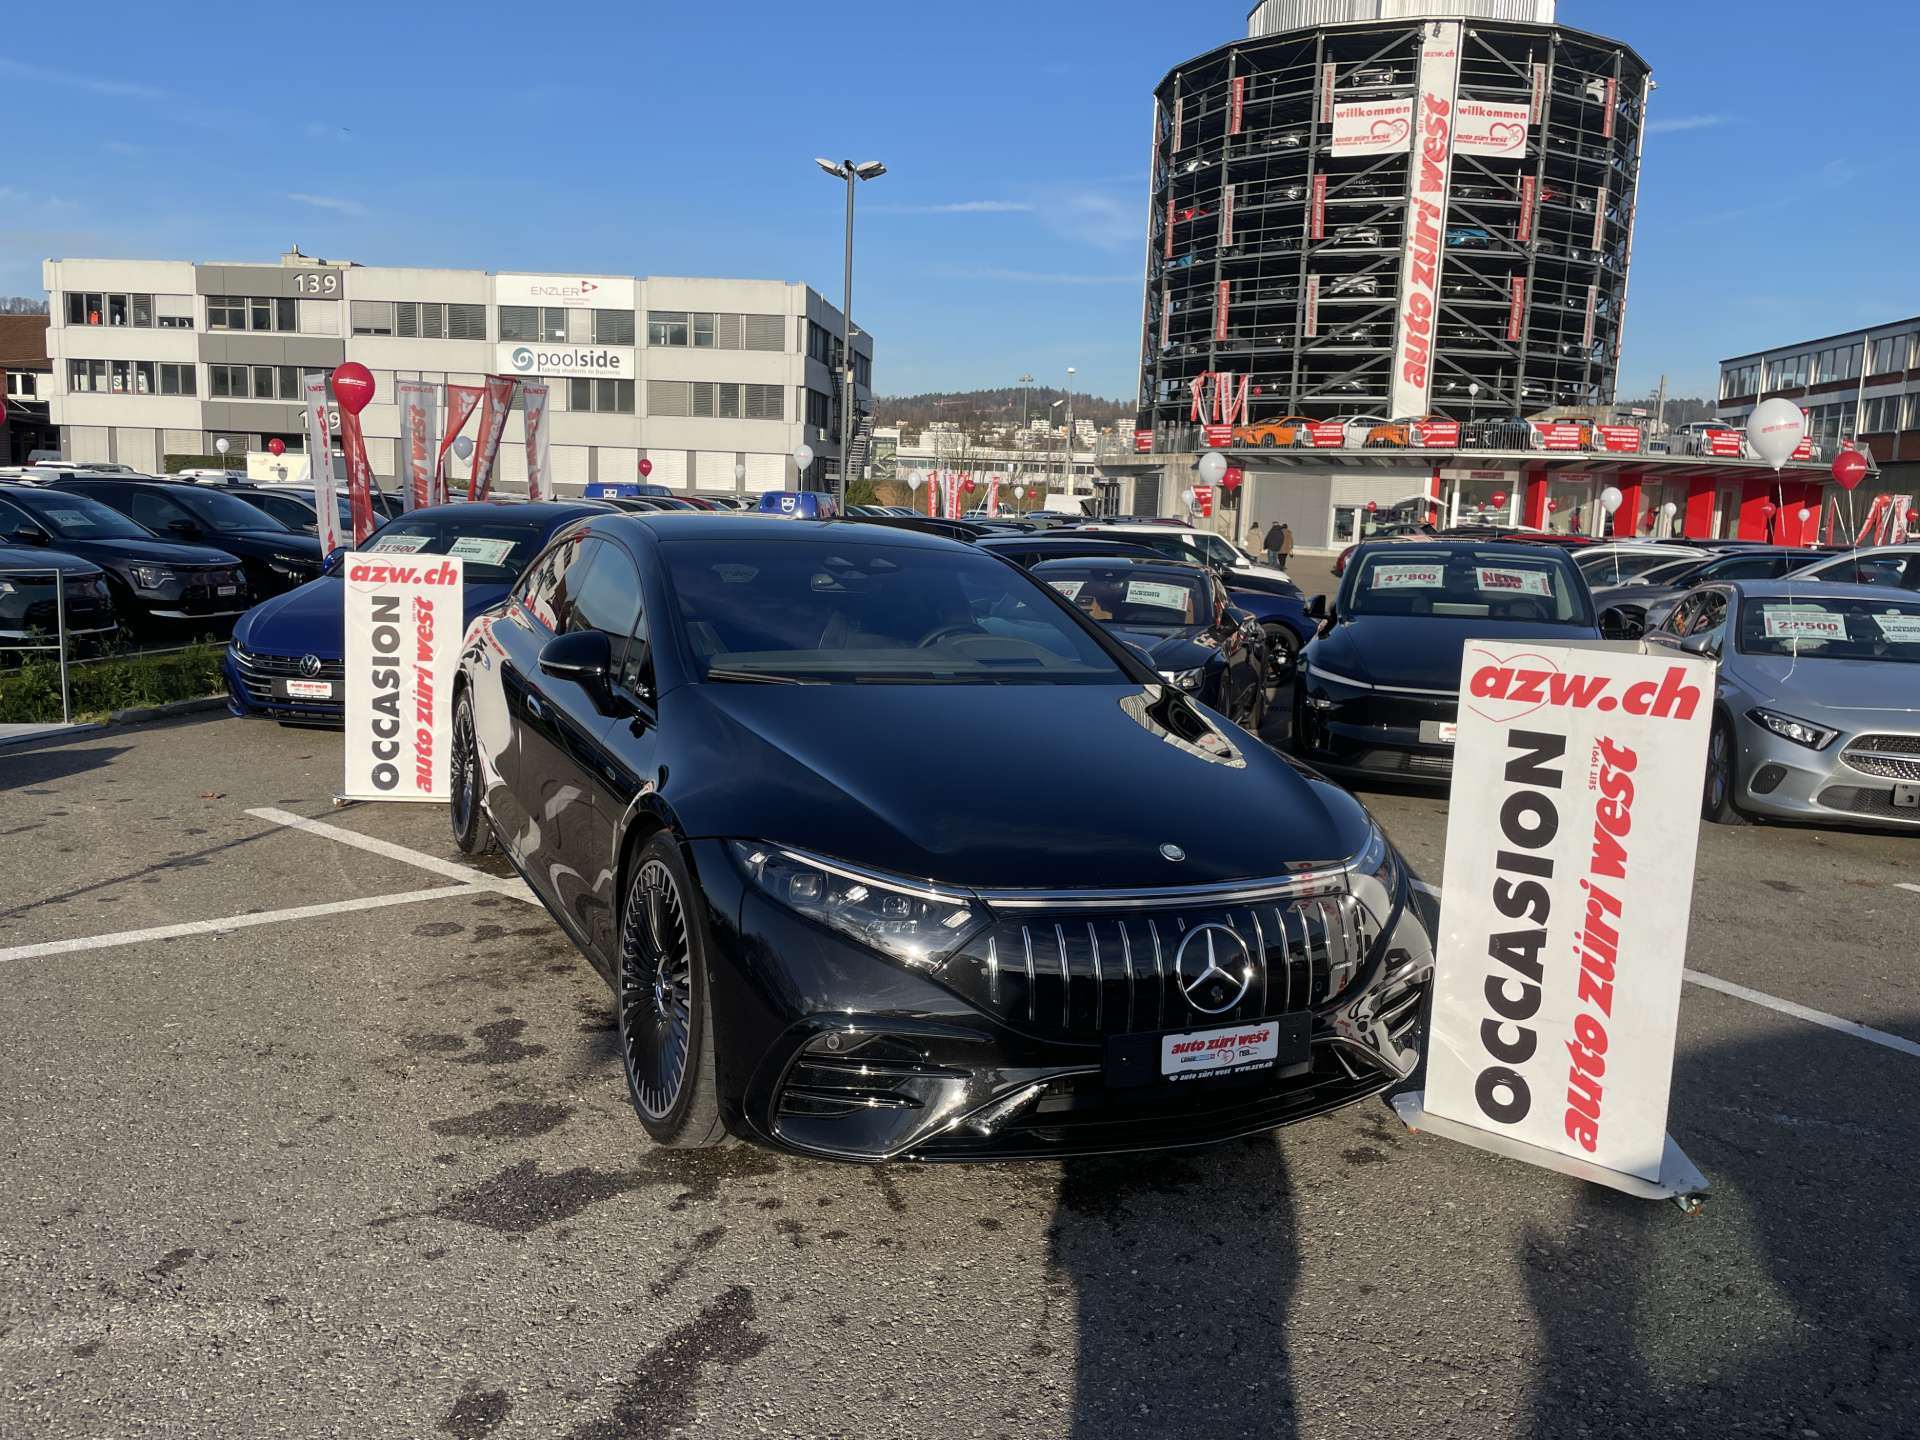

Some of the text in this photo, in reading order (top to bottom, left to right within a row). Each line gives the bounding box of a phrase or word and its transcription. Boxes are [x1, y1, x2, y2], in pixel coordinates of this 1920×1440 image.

[1335, 105, 1411, 118] willkommen
[1457, 105, 1527, 119] willkommen
[1403, 92, 1450, 388] auto züri west
[293, 274, 337, 294] 139
[530, 286, 580, 297] ENZLER
[537, 349, 620, 373] poolside
[298, 410, 341, 430] 19
[350, 561, 458, 586] azw.ch
[1384, 573, 1437, 582] 47'800
[1777, 621, 1839, 632] 22'500
[371, 595, 400, 791] OCCASION
[412, 595, 435, 794] auto züri west
[1469, 666, 1701, 721] azw.ch
[1588, 745, 1600, 791] SEIT 1991
[1474, 728, 1567, 1124] OCCASION
[1563, 735, 1638, 1153] auto züri west
[1171, 1029, 1270, 1055] auto züri west
